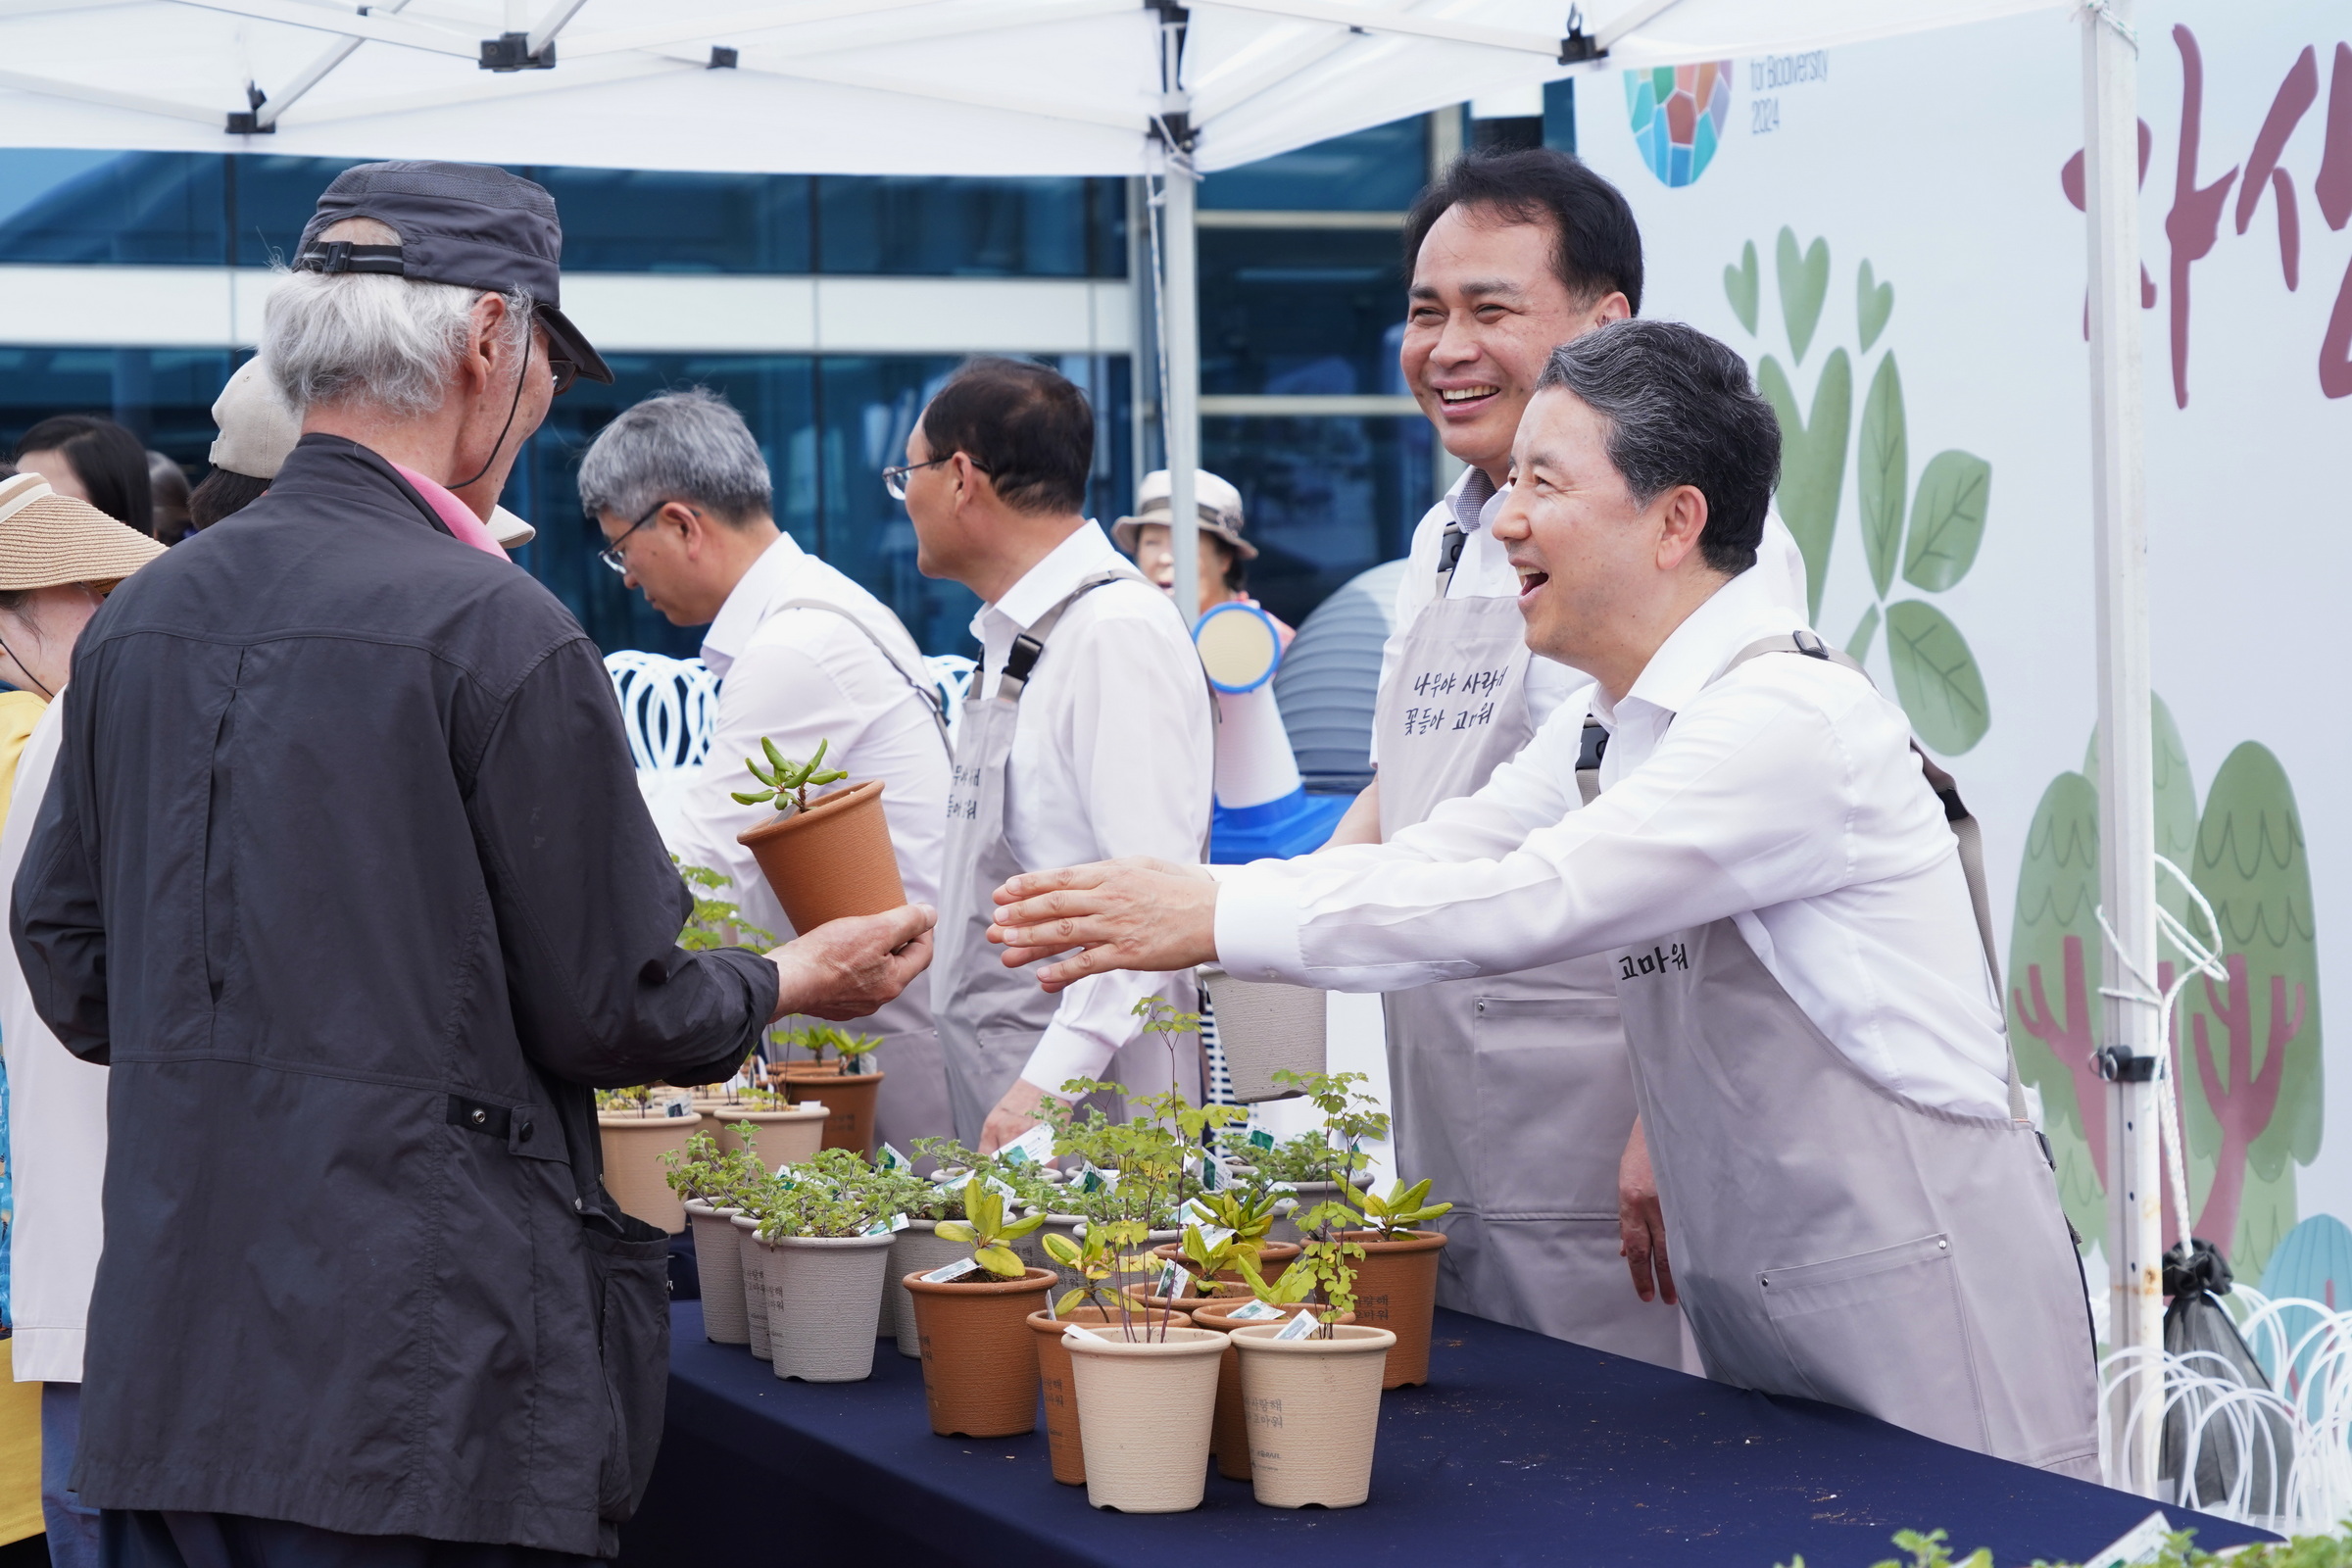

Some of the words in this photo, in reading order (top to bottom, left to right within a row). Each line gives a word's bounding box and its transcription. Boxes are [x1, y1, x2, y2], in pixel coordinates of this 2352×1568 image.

[1751, 97, 1780, 134] 2024
[1414, 672, 1456, 698] 나무야
[1404, 708, 1445, 736] 꽃들아
[1618, 943, 1690, 981] 고마워
